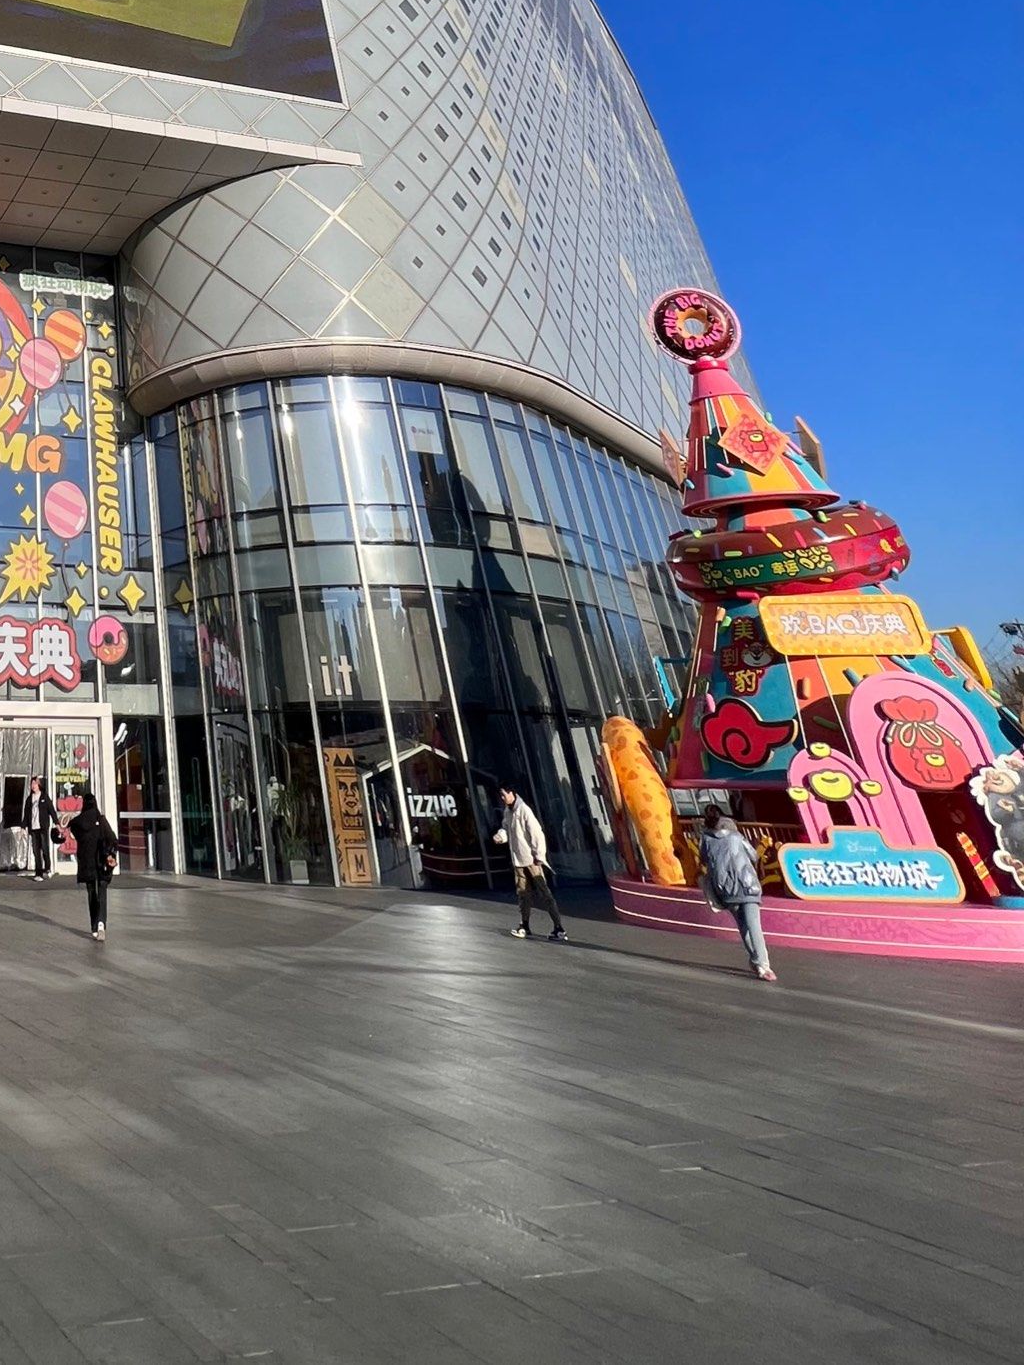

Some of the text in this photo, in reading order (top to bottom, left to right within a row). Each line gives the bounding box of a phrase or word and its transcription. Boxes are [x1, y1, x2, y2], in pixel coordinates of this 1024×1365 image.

[663, 293, 724, 351] THE BIG DONUT
[91, 357, 123, 574] CLAWHAUSER
[408, 787, 458, 822] izzue
[798, 859, 944, 890] 疯狂动物城
